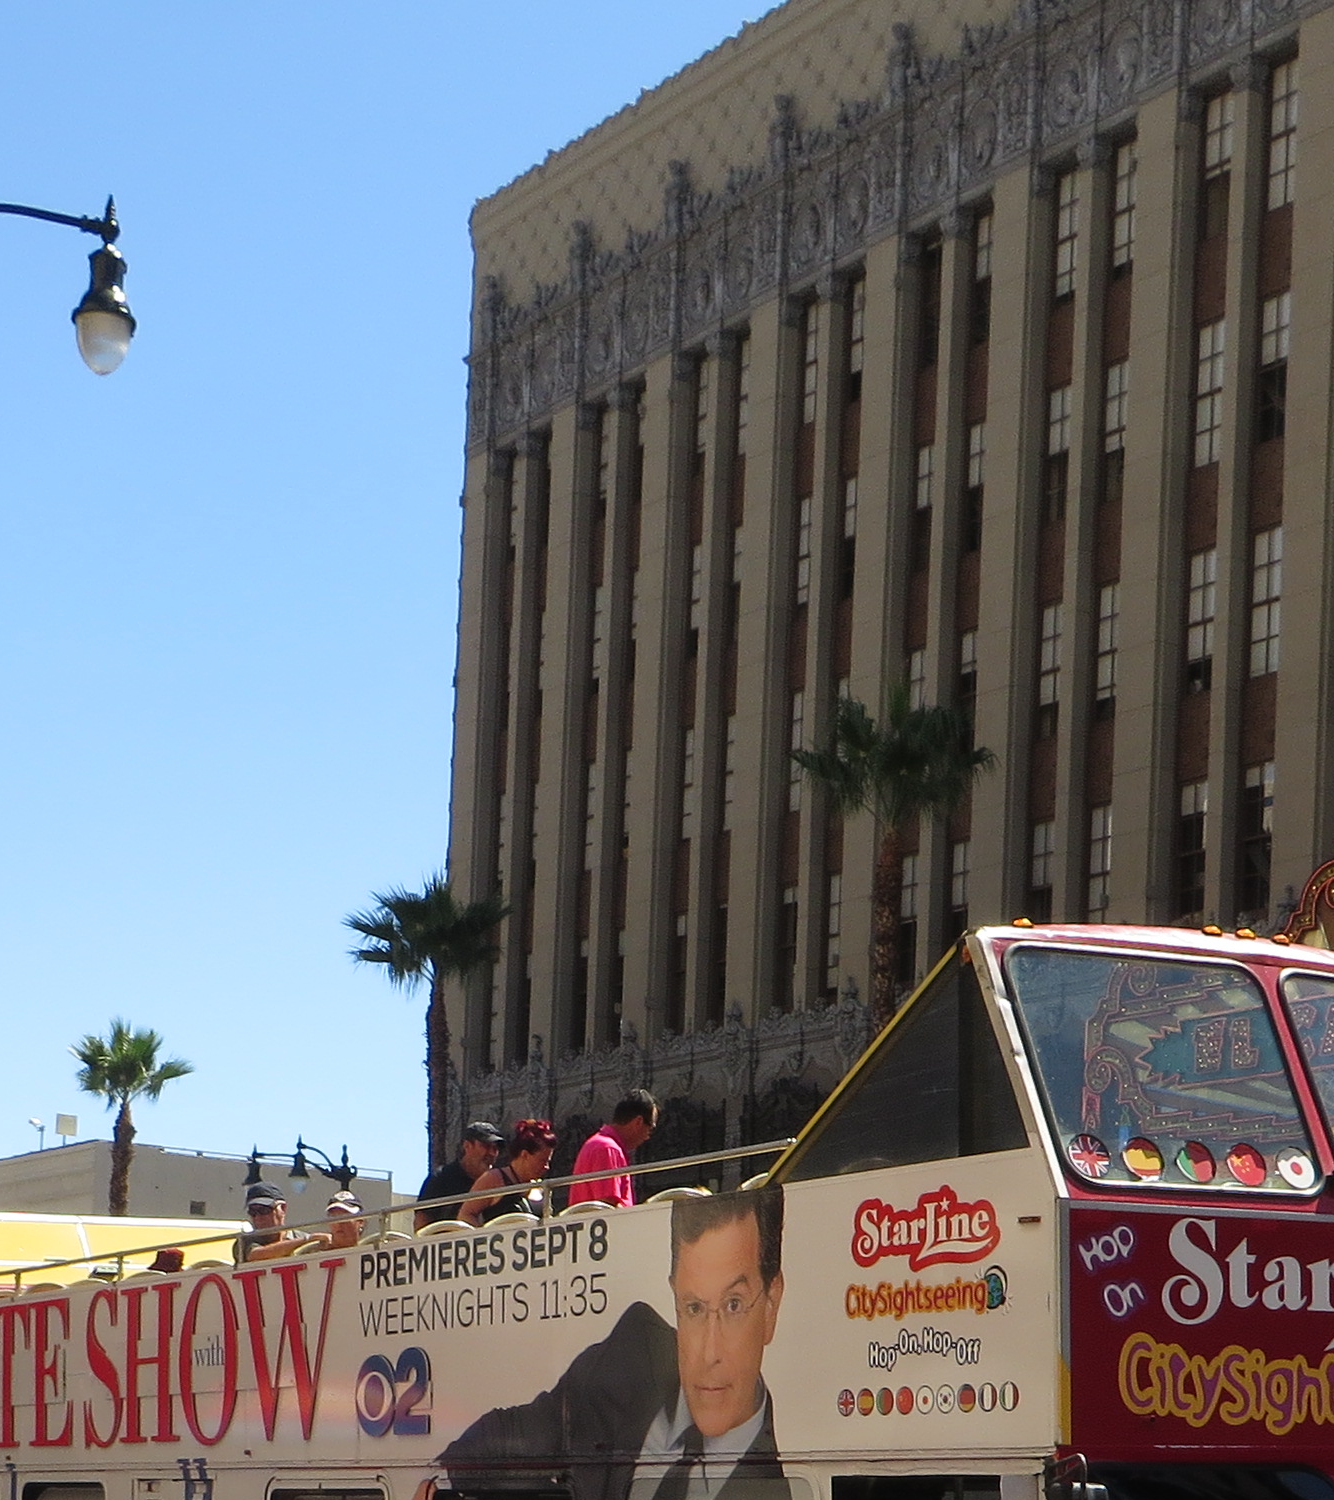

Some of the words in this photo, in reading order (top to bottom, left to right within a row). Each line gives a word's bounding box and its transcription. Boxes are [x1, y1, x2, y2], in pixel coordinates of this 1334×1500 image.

[1194, 1017, 1259, 1073] EL
[360, 1234, 505, 1290] PREMIERES
[512, 1222, 584, 1271] SEPT
[589, 1219, 608, 1261] 8
[857, 1197, 993, 1261] StarLine
[1078, 1223, 1135, 1271] Hop
[359, 1282, 529, 1337] WEEKNIGHTS
[540, 1273, 607, 1320] 11:35
[845, 1277, 988, 1320] CitySightseeing
[1101, 1278, 1146, 1319] On
[194, 1334, 226, 1369] with
